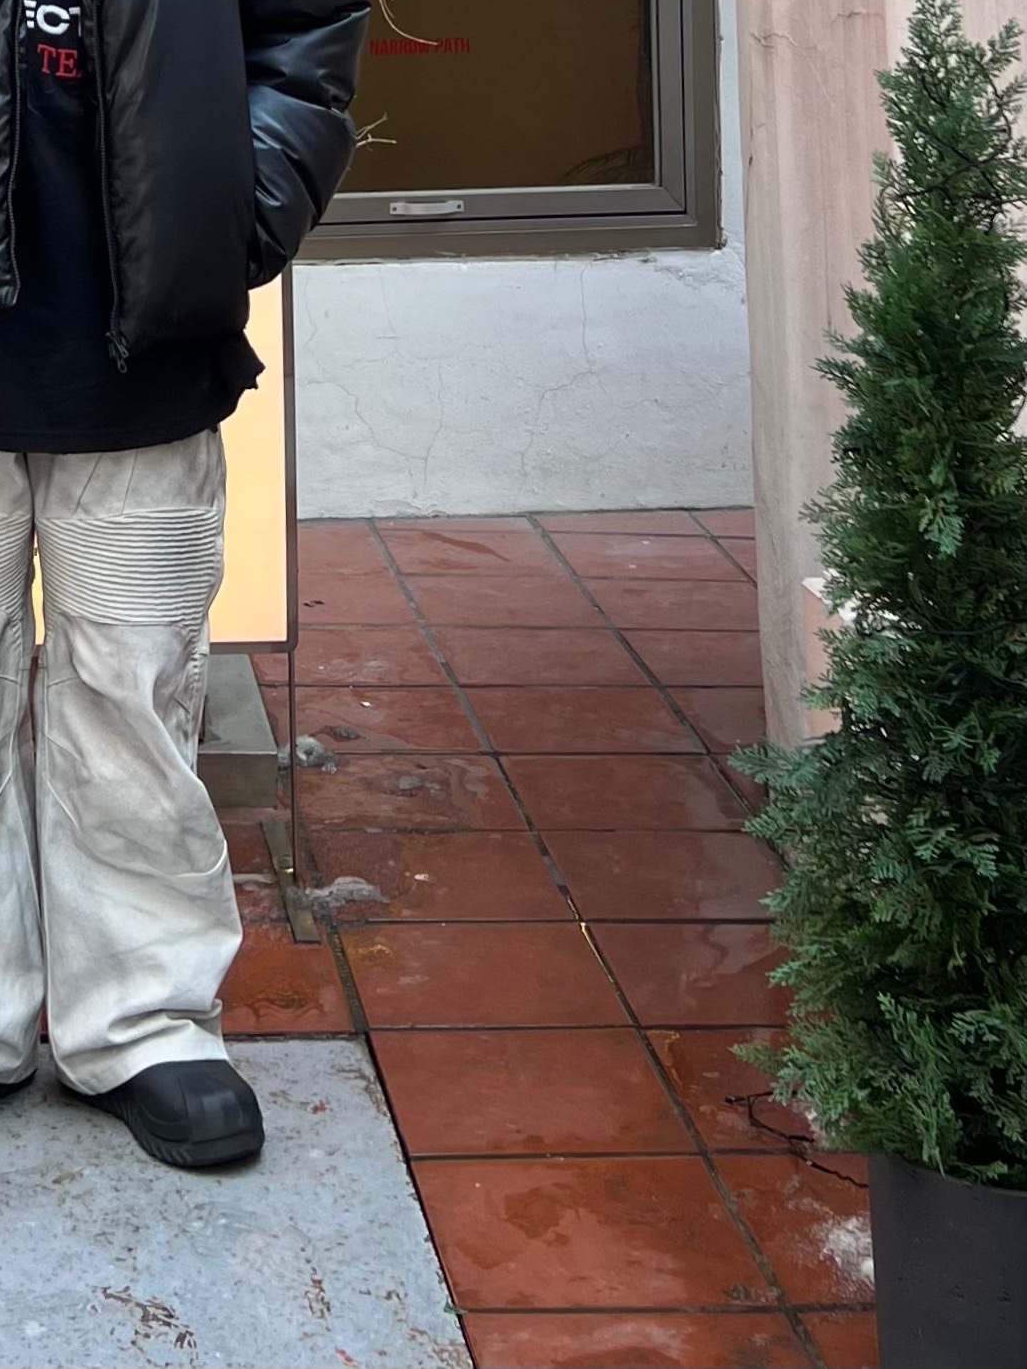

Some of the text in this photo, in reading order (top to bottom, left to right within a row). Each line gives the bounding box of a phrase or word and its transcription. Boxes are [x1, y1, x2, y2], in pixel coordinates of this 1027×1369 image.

[369, 36, 471, 55] NARROW PATH
[37, 43, 82, 78] TE
